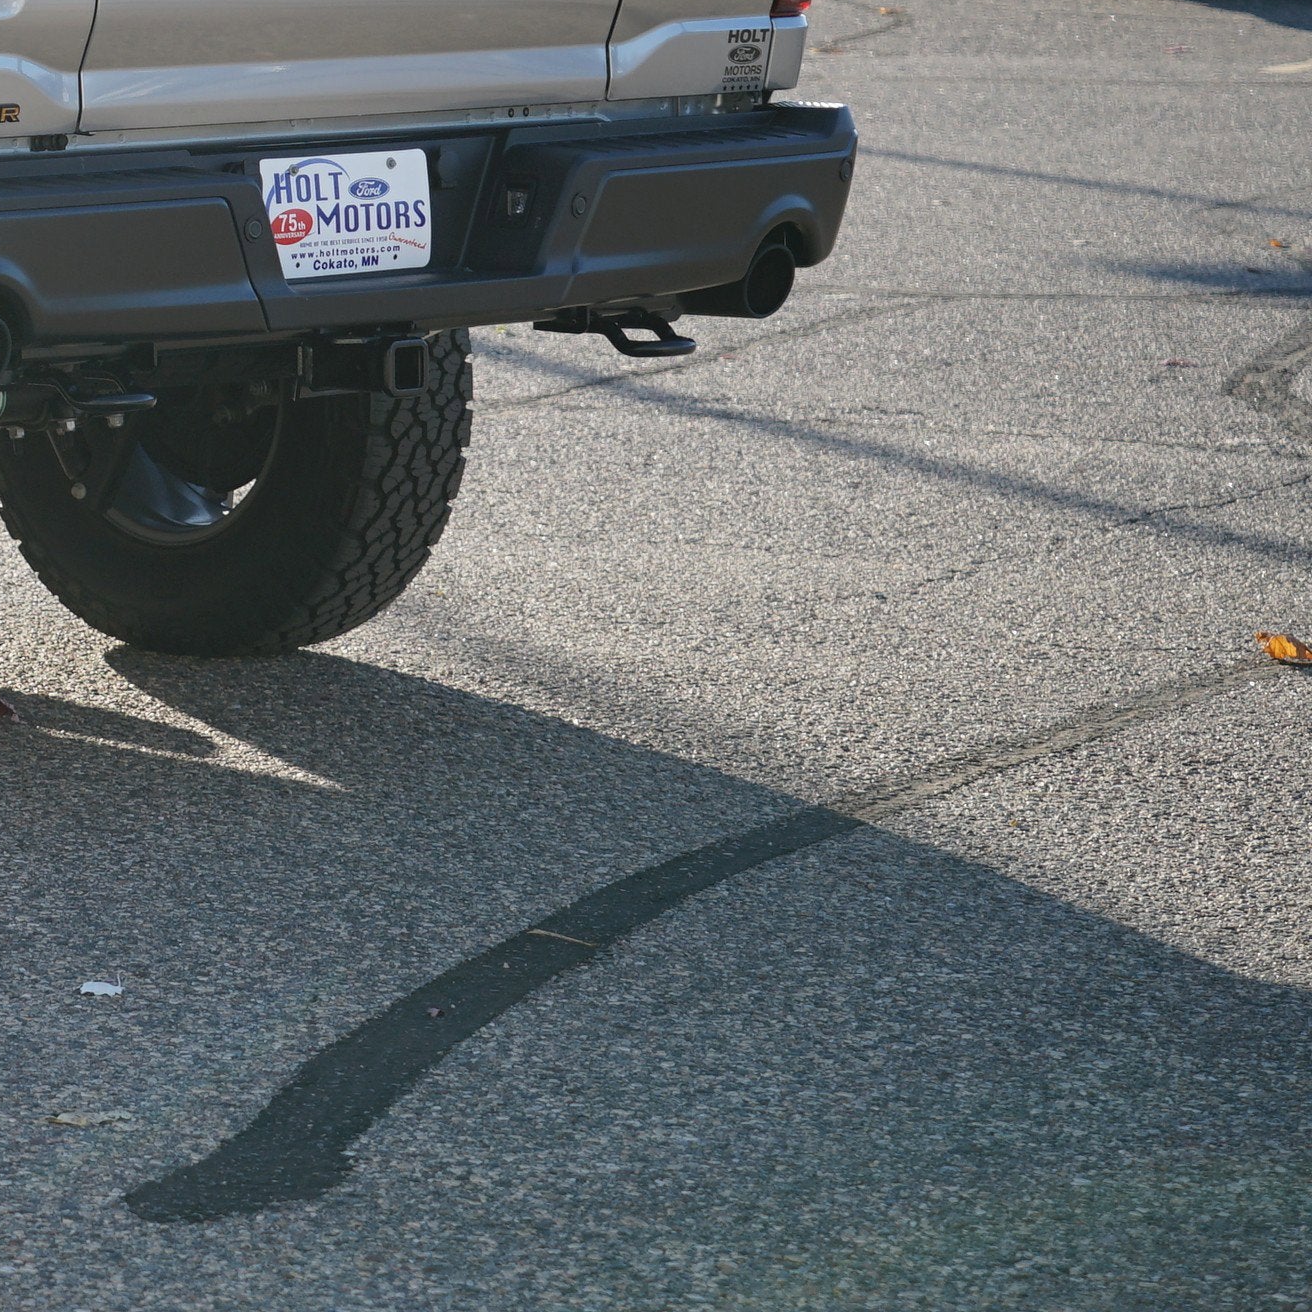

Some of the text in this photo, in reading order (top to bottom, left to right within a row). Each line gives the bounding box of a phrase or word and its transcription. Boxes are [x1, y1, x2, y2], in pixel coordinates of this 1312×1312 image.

[728, 29, 770, 43] HOLT
[724, 65, 763, 76] MOTORS
[274, 172, 382, 204] HOLT Ford
[278, 199, 426, 234] 75th MOTORS
[291, 245, 401, 260] www.holtmotors.com
[313, 255, 379, 271] Cokato, MN
